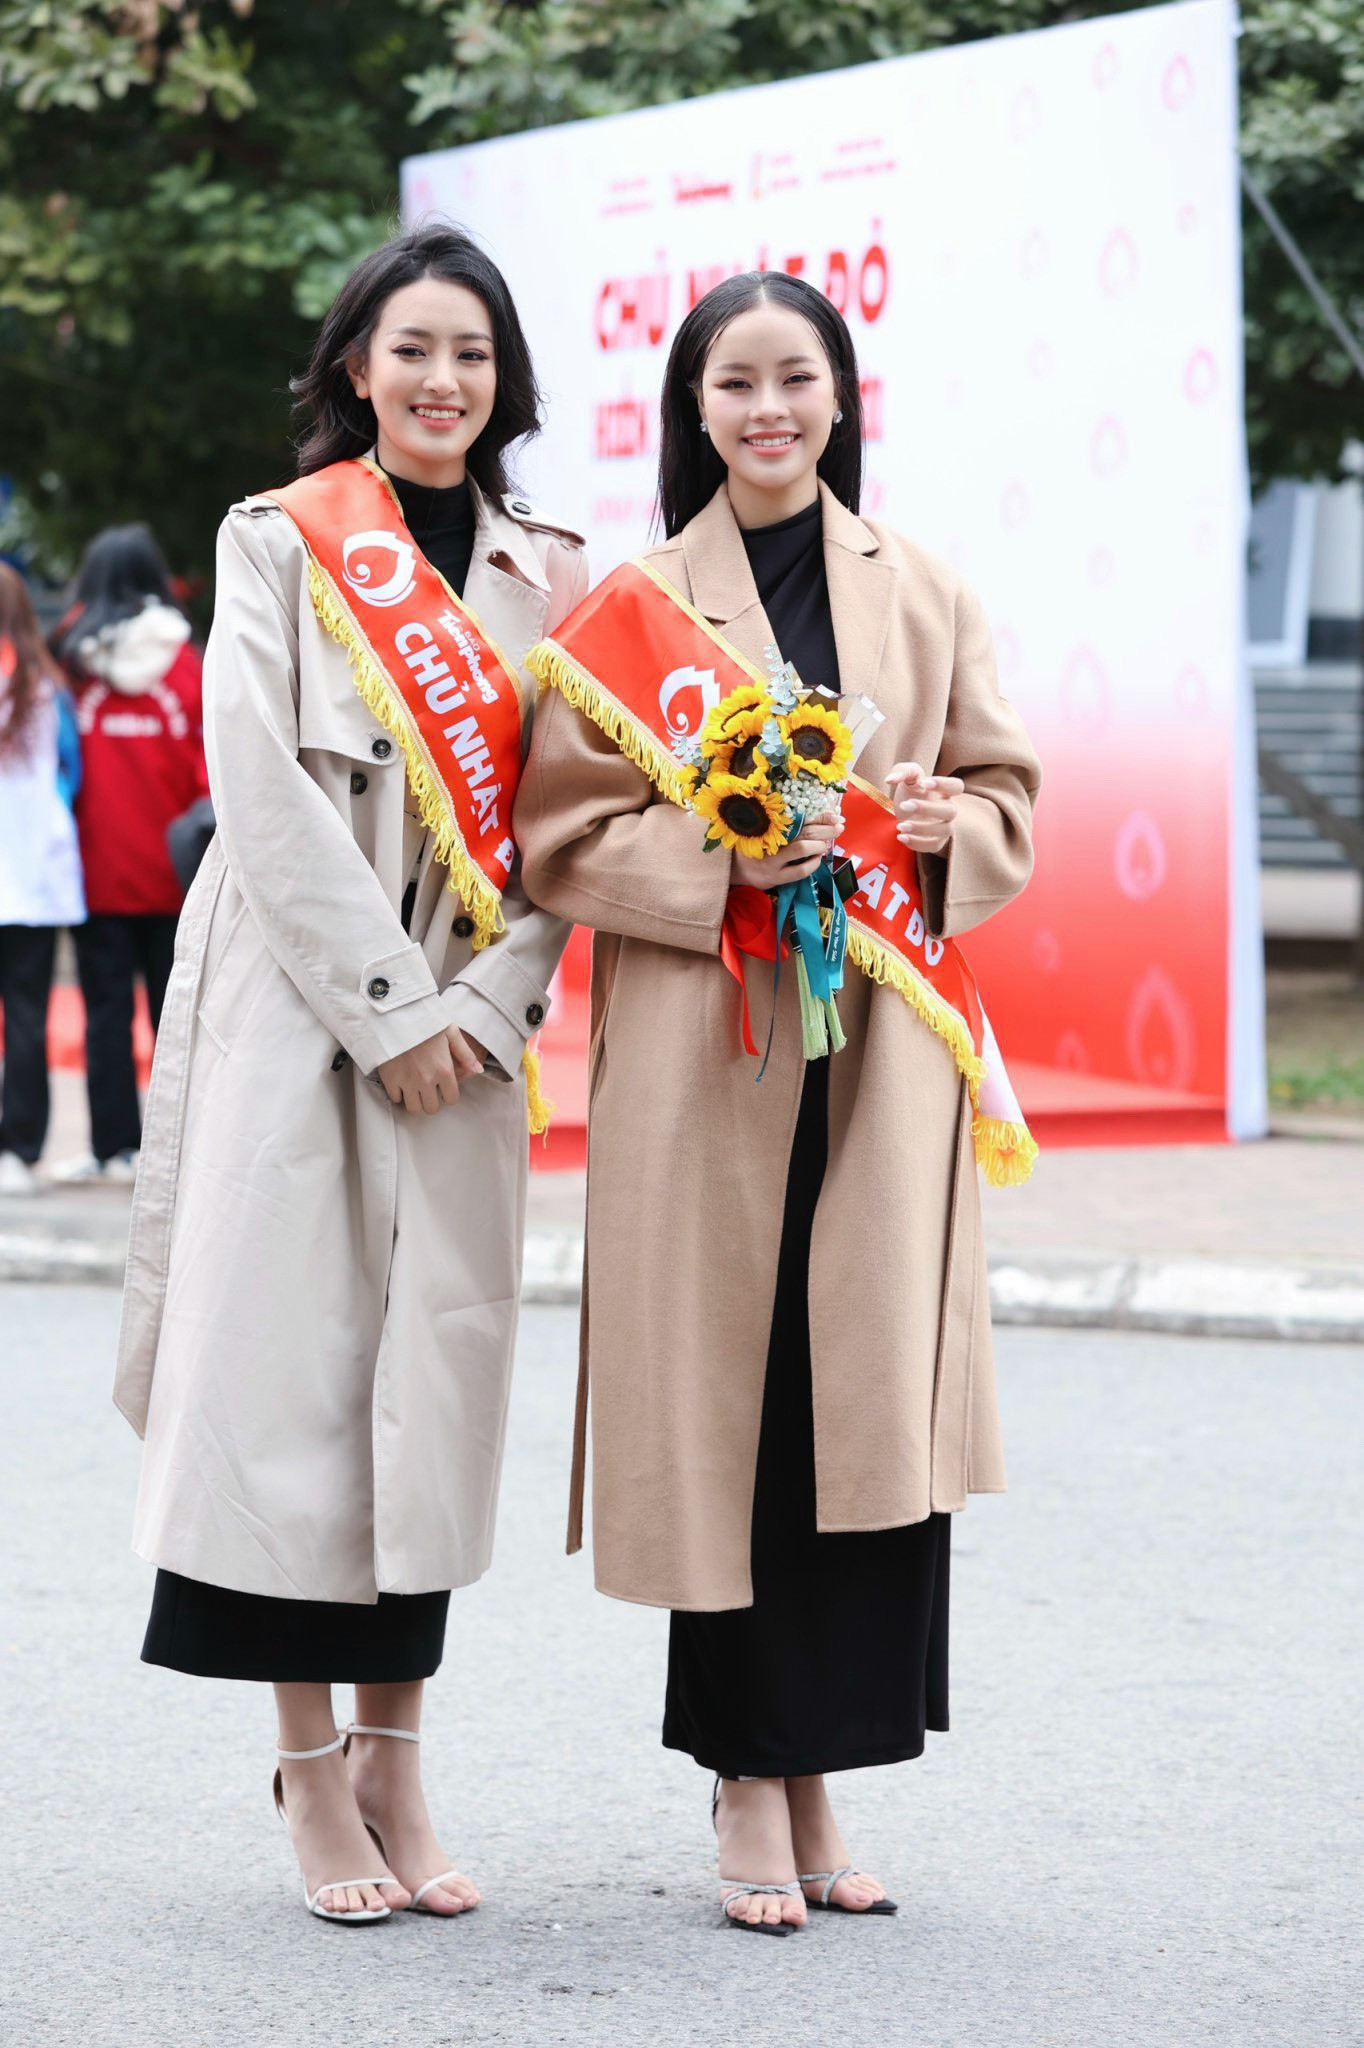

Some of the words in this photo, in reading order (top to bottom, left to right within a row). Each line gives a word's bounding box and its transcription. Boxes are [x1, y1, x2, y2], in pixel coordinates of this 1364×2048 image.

[394, 622, 470, 715] CHỦ
[442, 715, 502, 837] NHẬT
[493, 836, 515, 873] Đ
